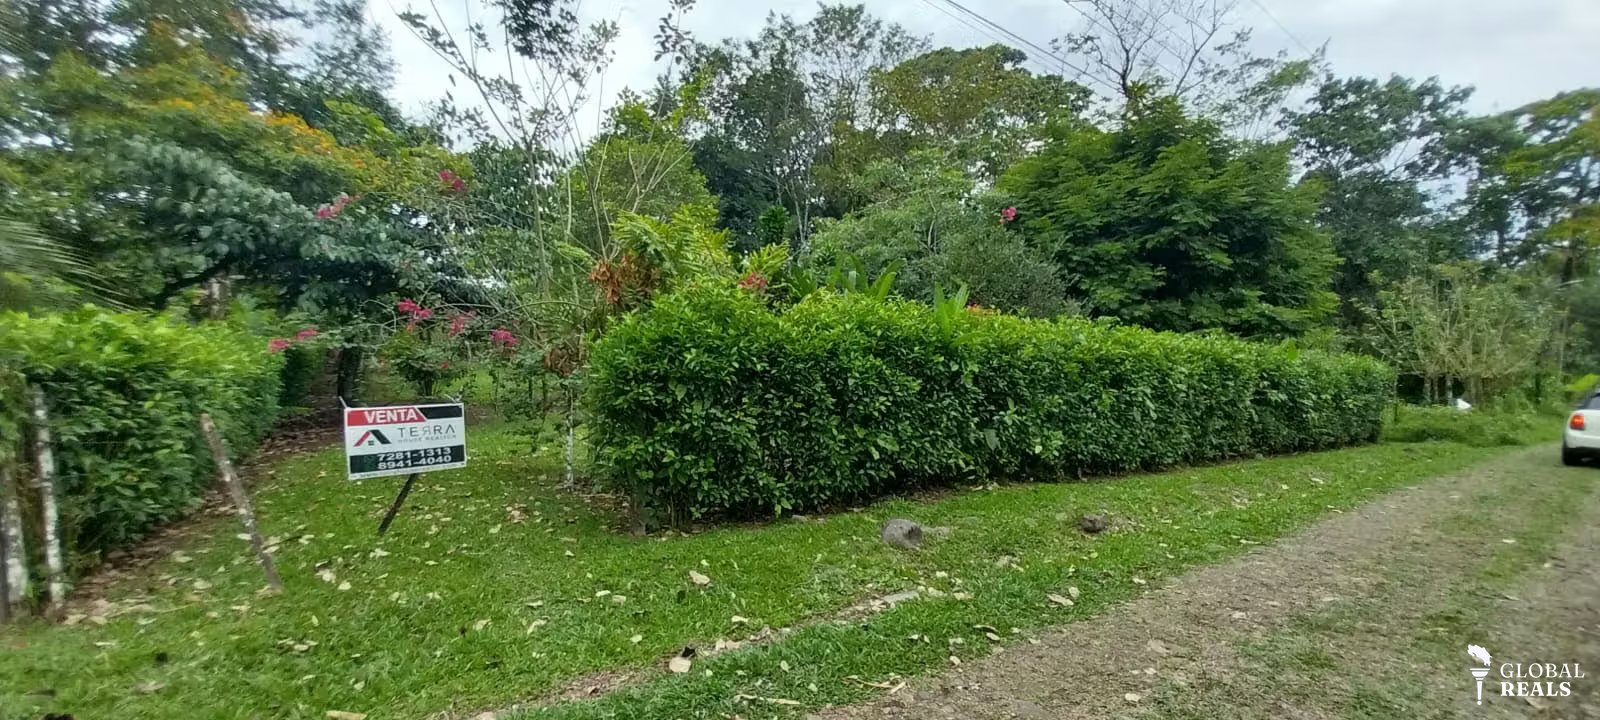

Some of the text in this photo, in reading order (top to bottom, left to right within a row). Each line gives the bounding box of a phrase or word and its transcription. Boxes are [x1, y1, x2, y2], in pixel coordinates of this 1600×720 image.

[364, 408, 418, 424] VENTA
[377, 447, 452, 461] 7281-1313
[377, 455, 452, 470] 8941-4040
